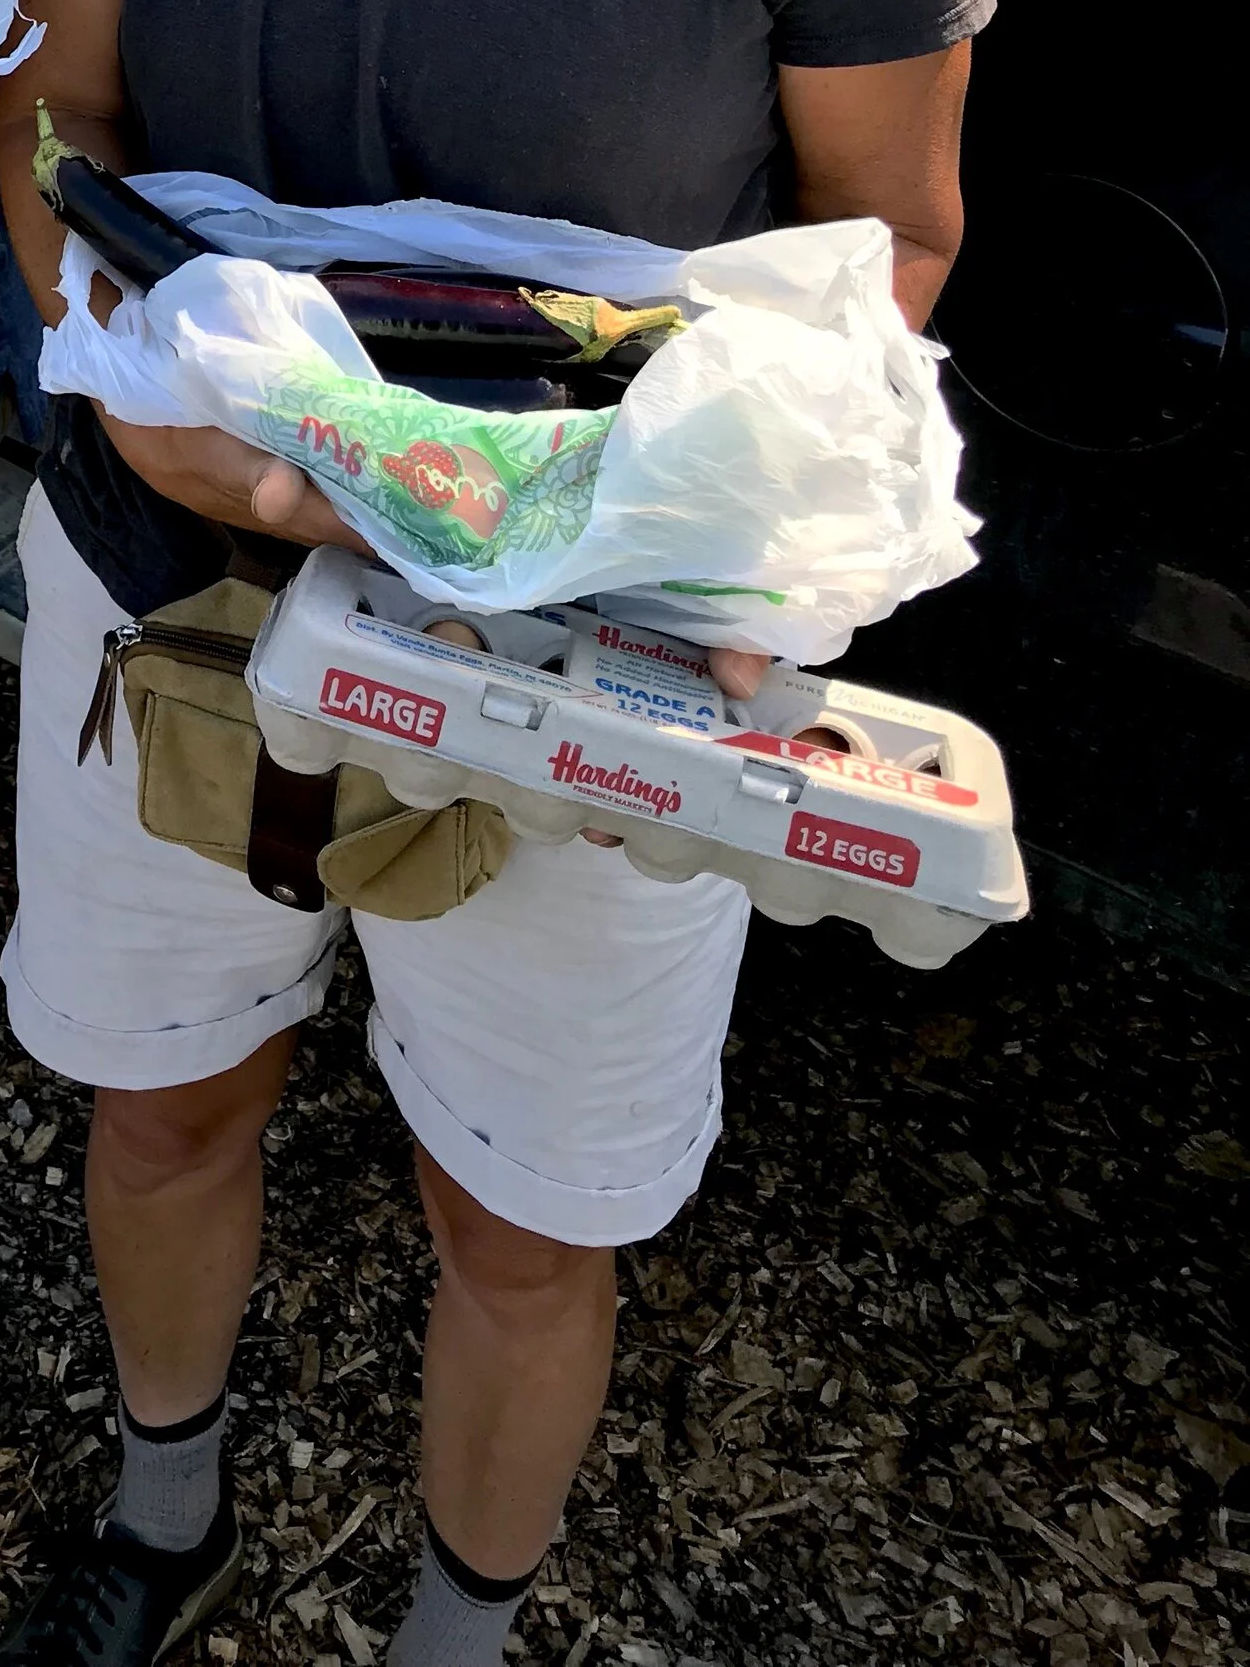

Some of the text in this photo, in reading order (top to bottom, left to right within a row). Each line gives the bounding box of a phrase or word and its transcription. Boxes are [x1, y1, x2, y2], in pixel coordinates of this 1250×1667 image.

[591, 624, 714, 679] Harding's
[327, 676, 439, 739] LARGE
[595, 677, 687, 713] GRADE
[696, 705, 716, 719] A
[785, 680, 826, 698] PURE
[617, 698, 642, 715] 12
[647, 708, 710, 732] EGGS
[547, 740, 682, 818] Harding's
[573, 785, 614, 803] FRIENDLY
[779, 741, 940, 799] LARGE
[796, 827, 905, 876] 12 EGGS
